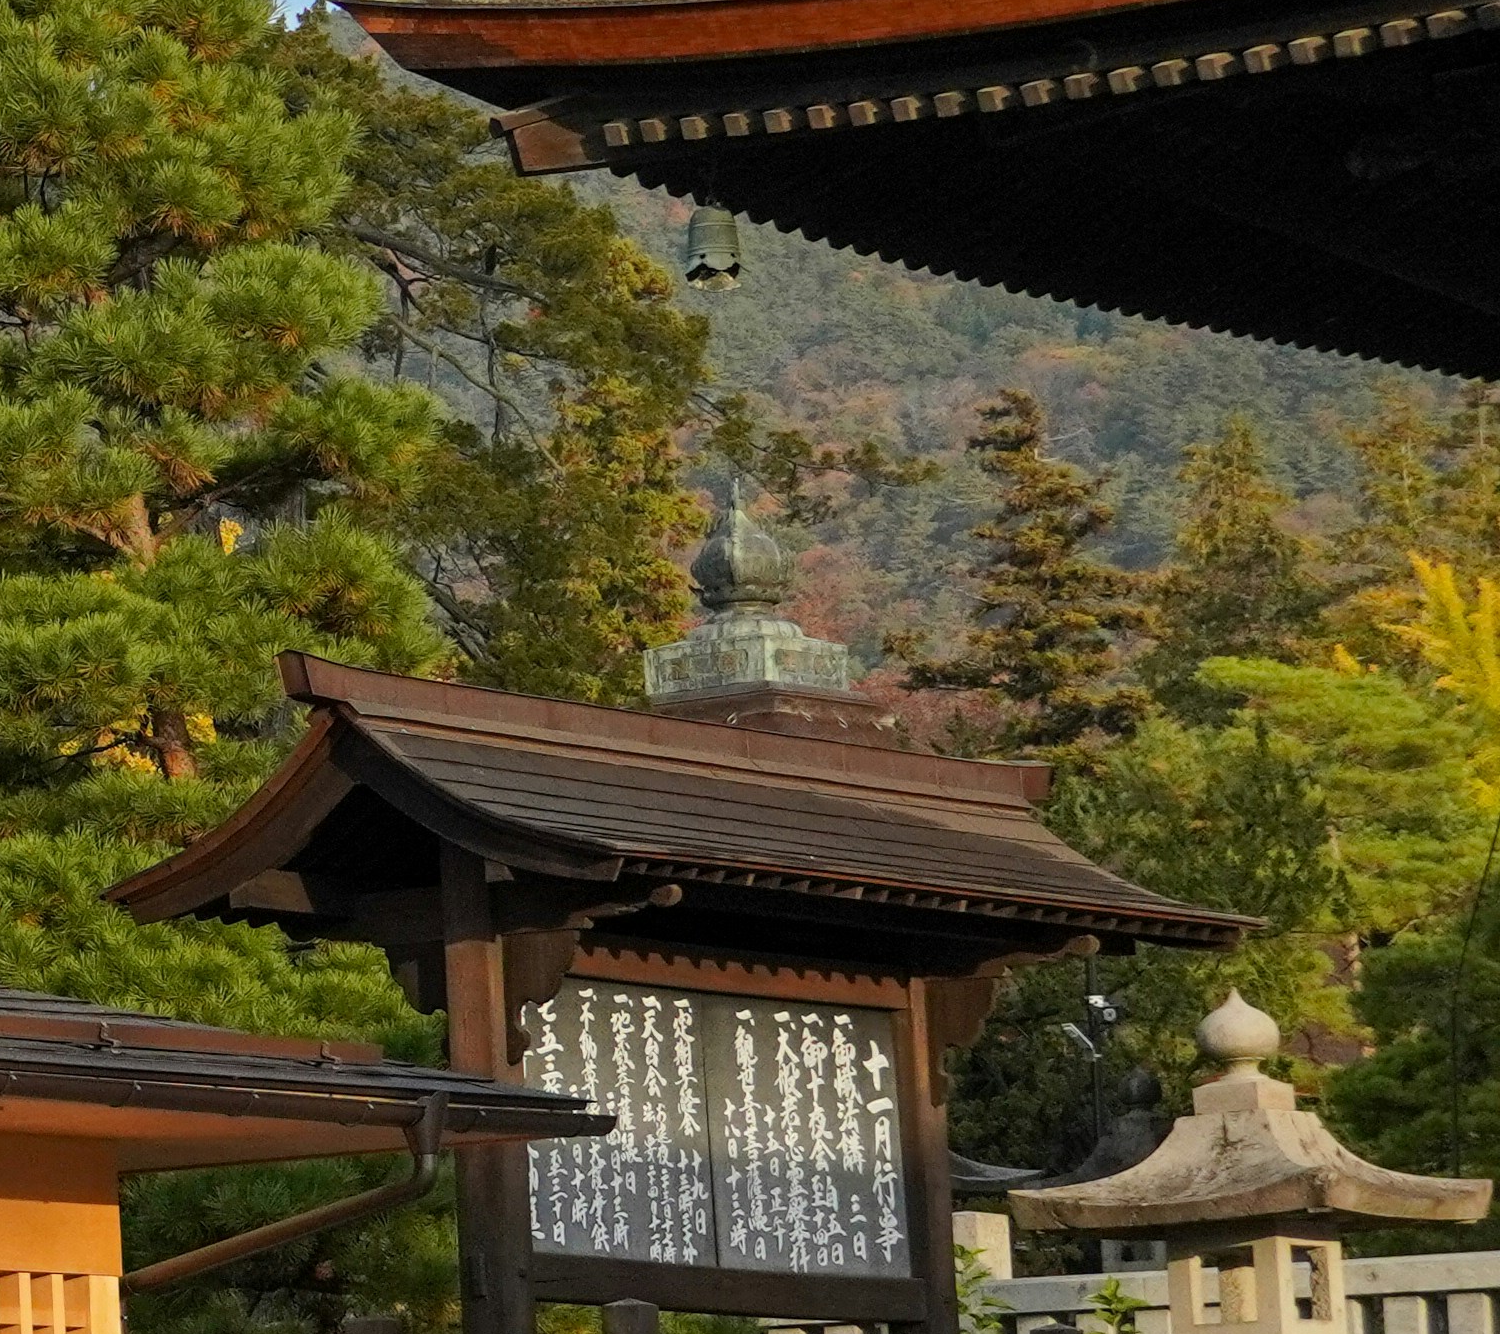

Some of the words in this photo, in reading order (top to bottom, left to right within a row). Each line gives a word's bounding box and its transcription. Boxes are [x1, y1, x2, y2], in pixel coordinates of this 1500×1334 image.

[723, 1097, 742, 1160] 十八日
[763, 1104, 785, 1177] 十五日
[862, 1039, 905, 1264] 十一月行事
[691, 1149, 709, 1236] 十九日
[725, 1165, 748, 1256] 十三時
[768, 1186, 788, 1253] 正午
[850, 1194, 868, 1264] 三日
